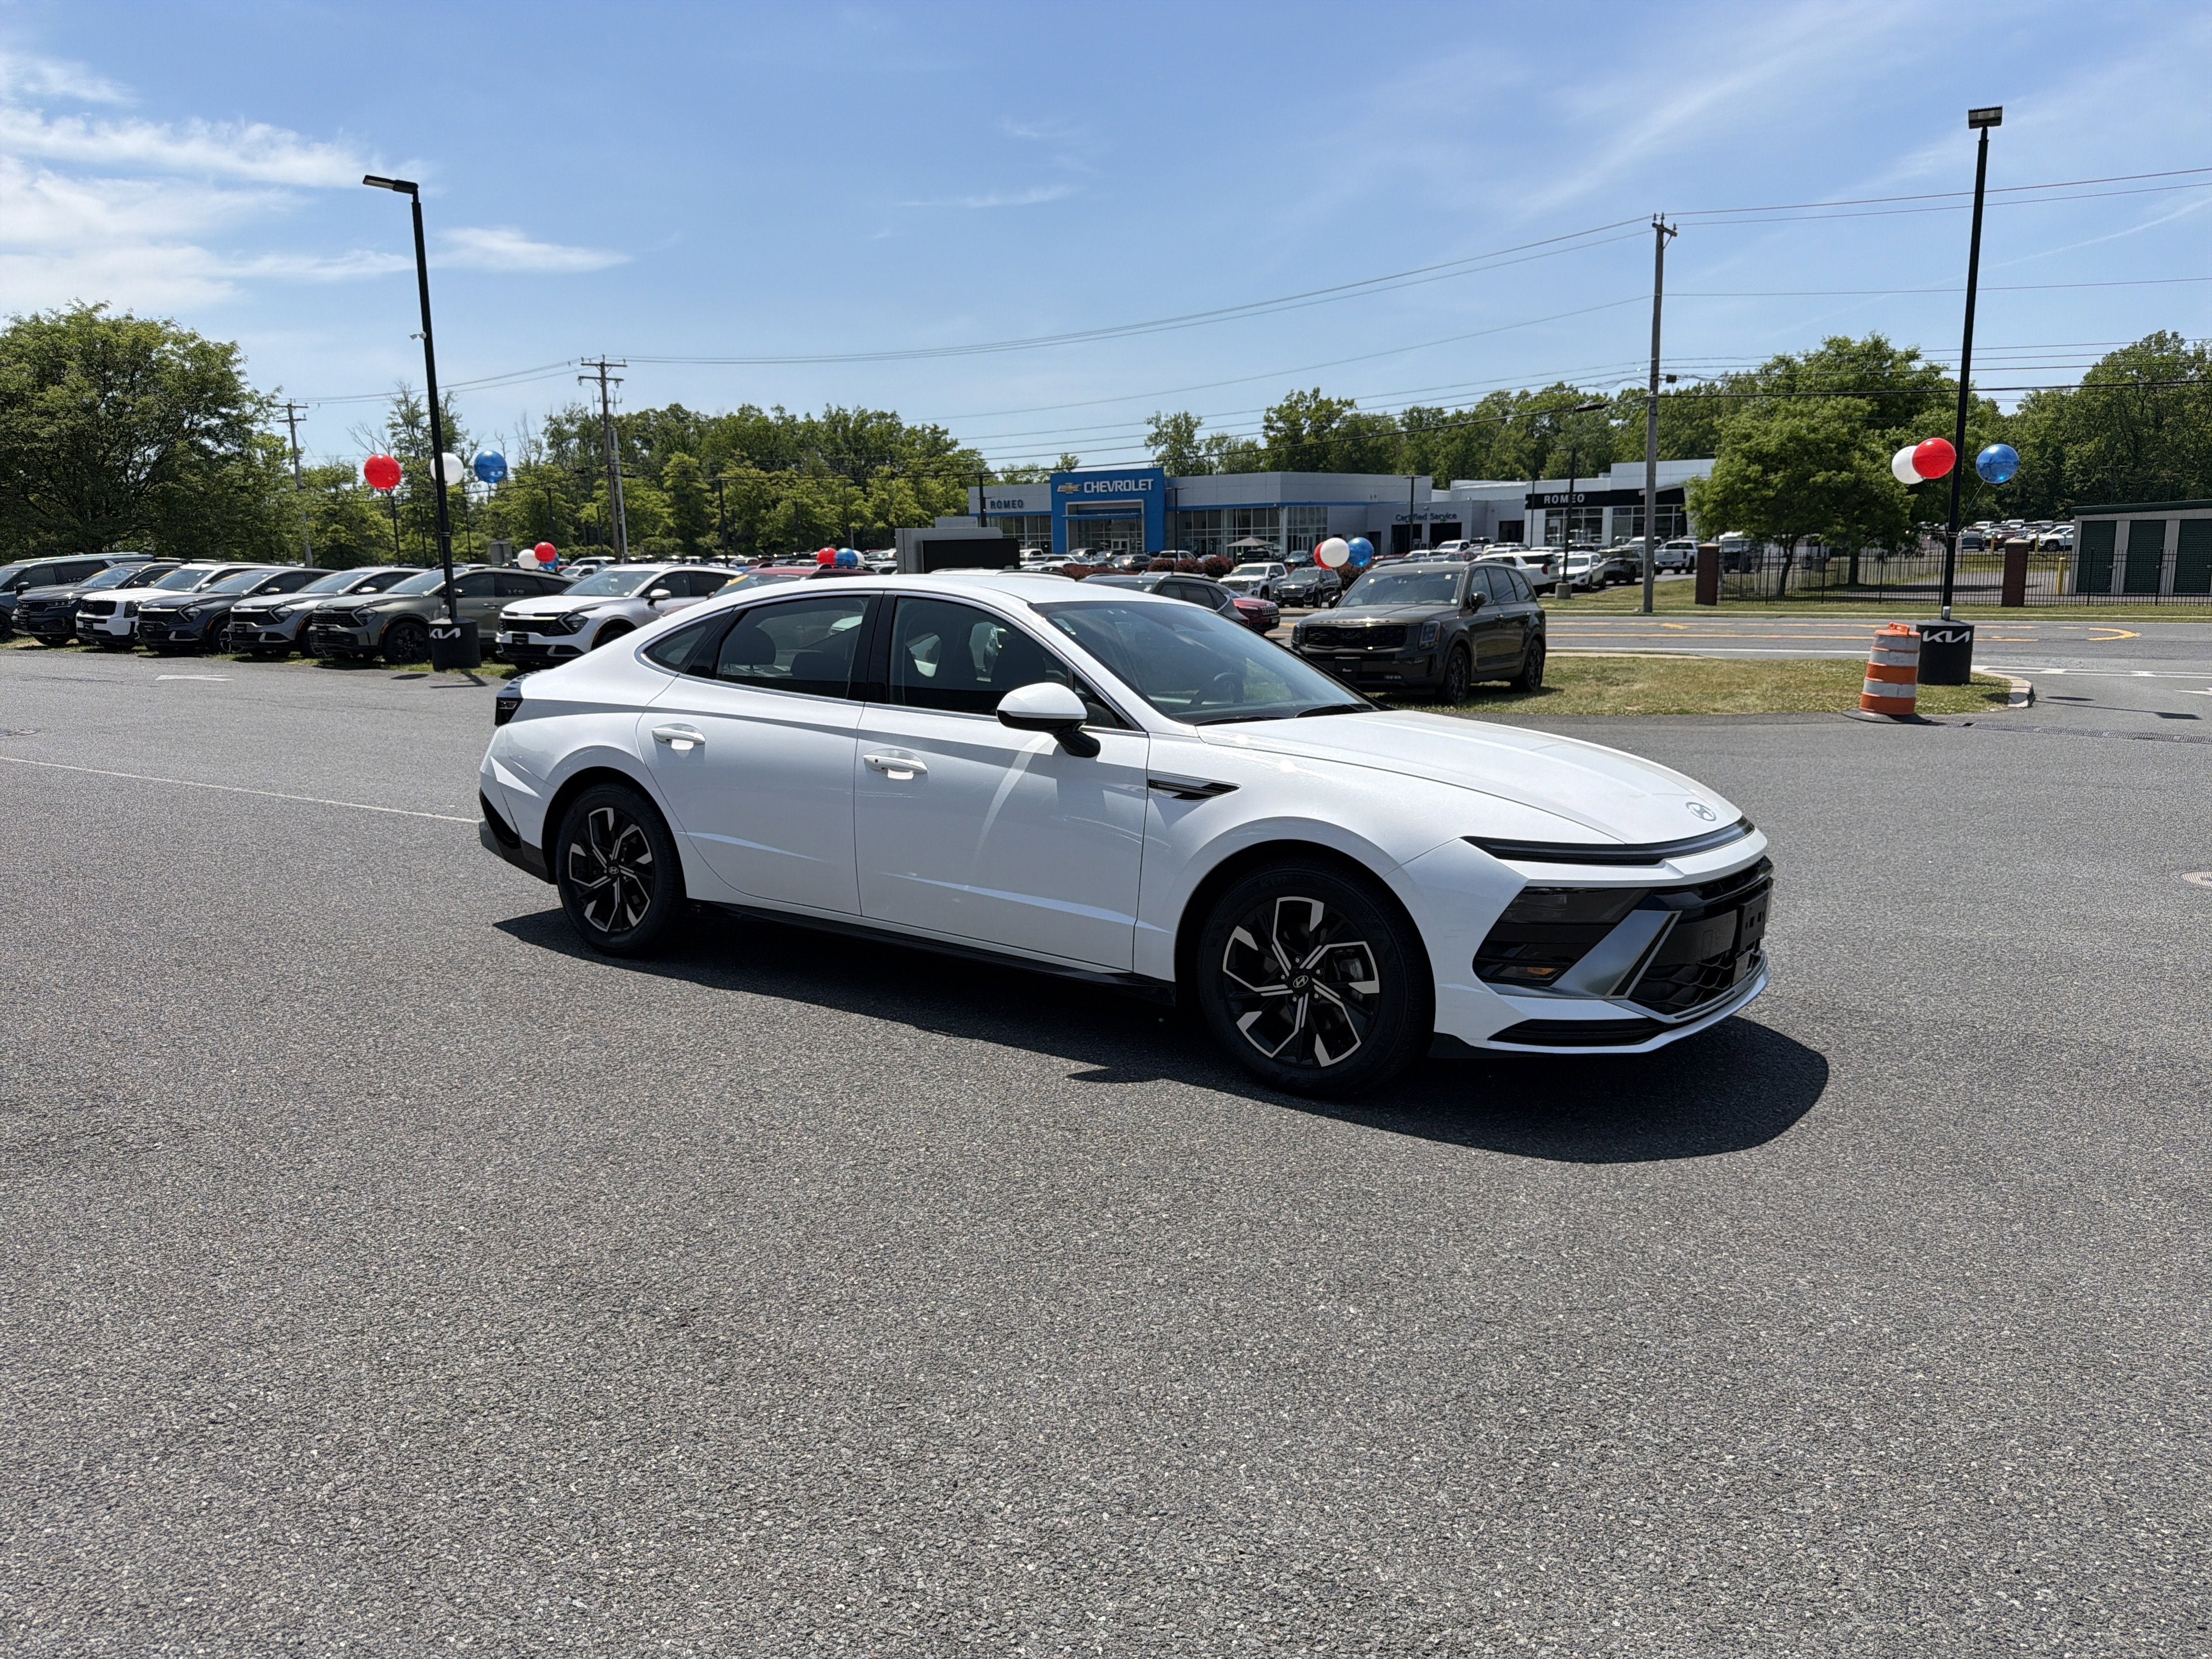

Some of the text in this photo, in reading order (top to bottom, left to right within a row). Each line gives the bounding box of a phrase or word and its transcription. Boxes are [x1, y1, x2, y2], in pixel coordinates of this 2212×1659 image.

[1084, 479, 1154, 494] CHEVROLET
[990, 499, 1024, 509] ROMEO
[1544, 494, 1585, 504] ROMEO
[1429, 512, 1458, 521] Service
[1922, 630, 1971, 643] KIA
